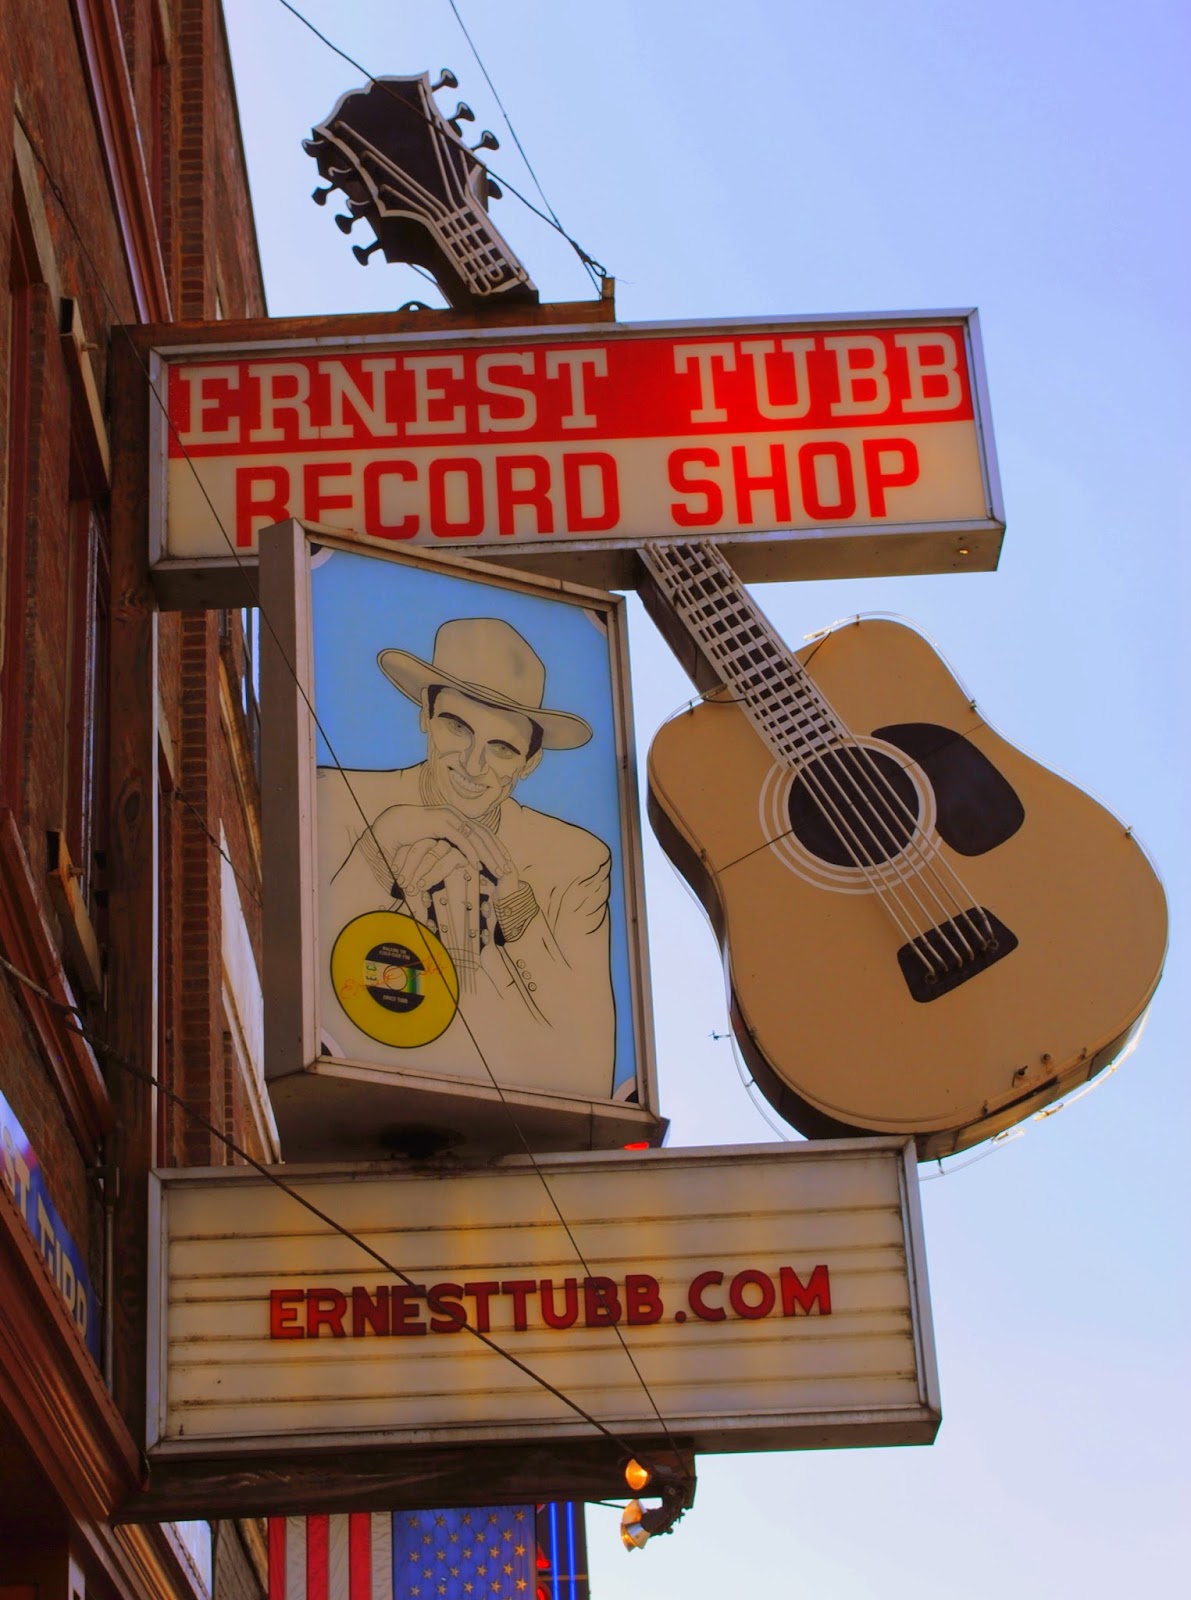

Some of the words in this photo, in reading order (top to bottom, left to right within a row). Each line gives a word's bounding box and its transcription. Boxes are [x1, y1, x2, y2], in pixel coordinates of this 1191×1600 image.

[179, 348, 608, 446] ERNEST
[673, 332, 963, 424] TUBB
[235, 451, 619, 548] RECORD
[667, 438, 920, 527] SHOP
[269, 1264, 833, 1340] ERNESTTUBB.COM
